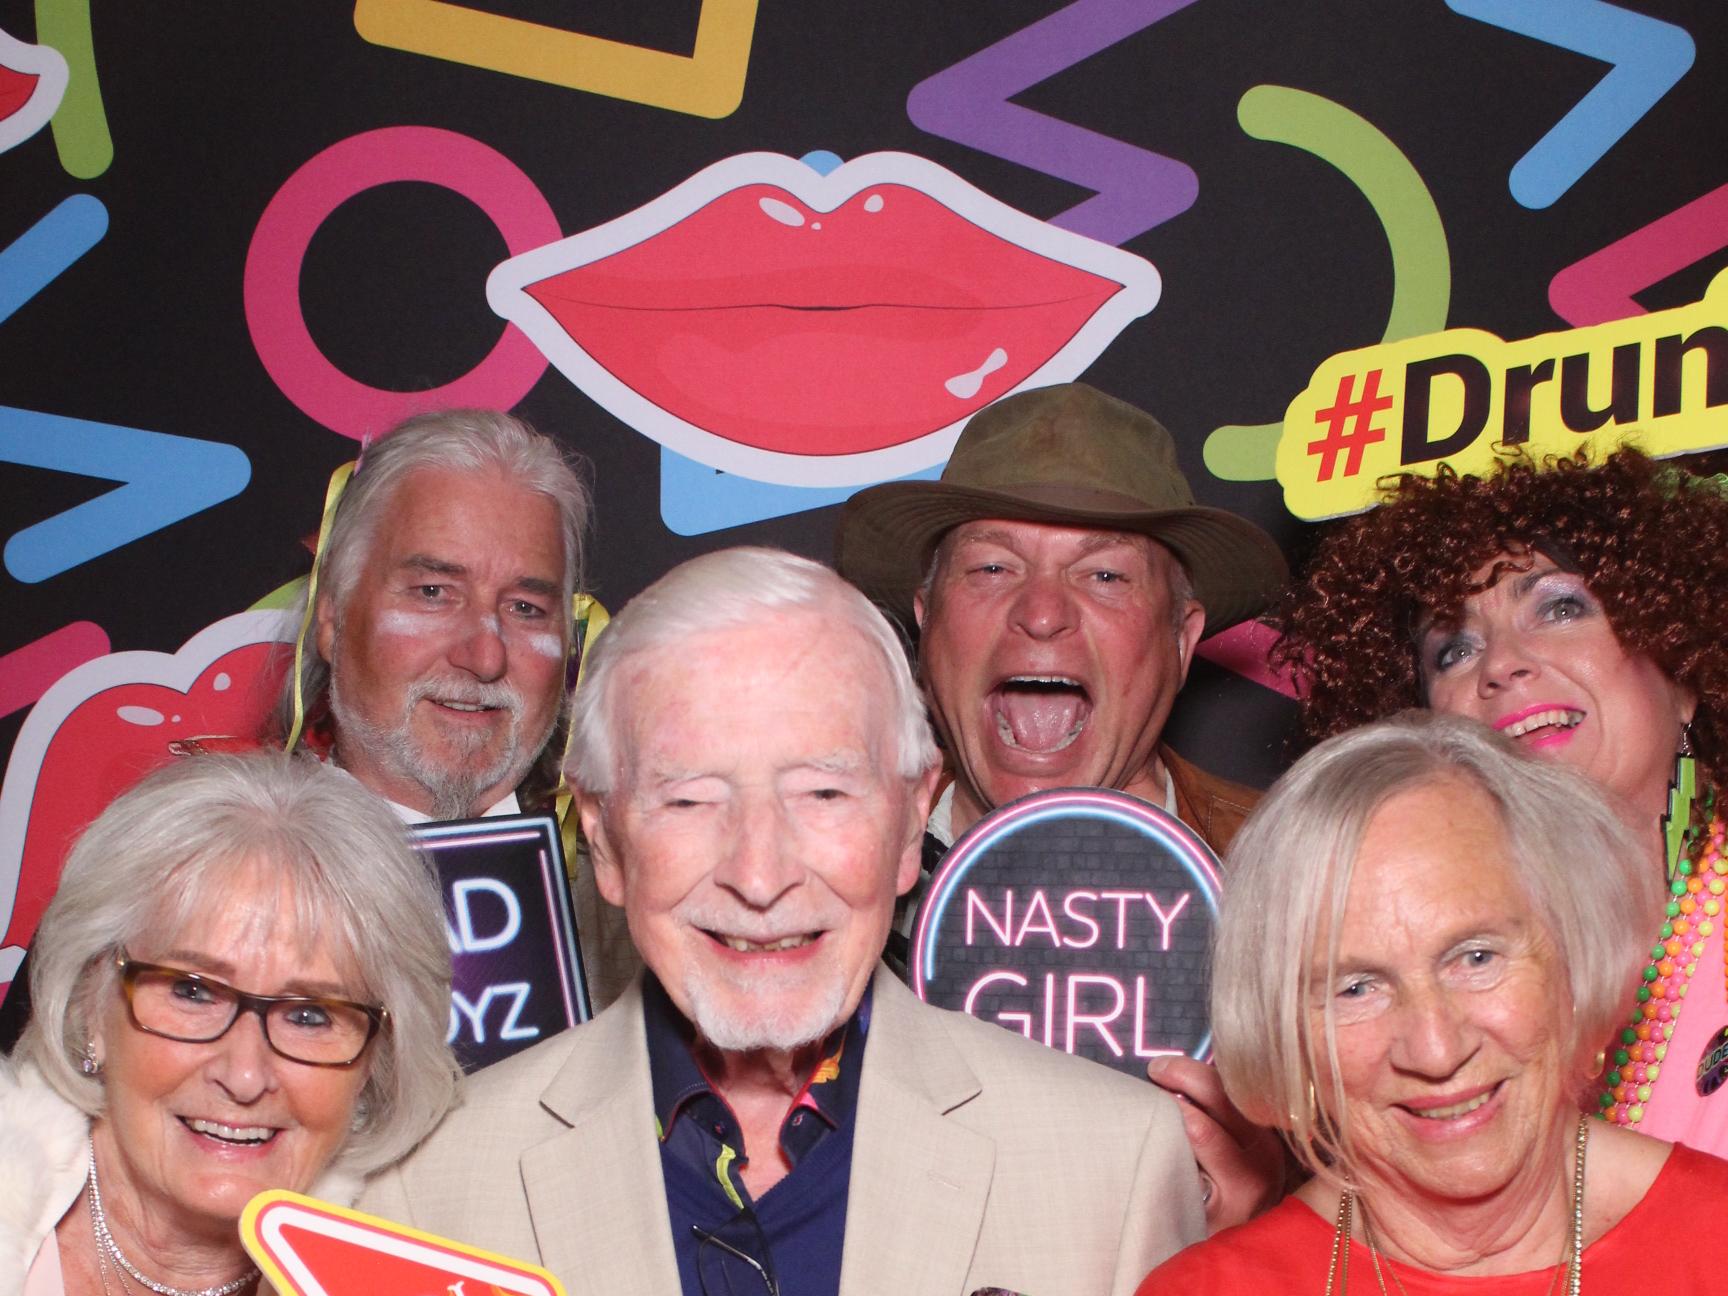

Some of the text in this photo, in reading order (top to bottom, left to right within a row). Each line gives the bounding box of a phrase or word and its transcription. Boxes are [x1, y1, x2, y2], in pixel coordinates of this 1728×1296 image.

[964, 888, 1190, 950] NASTY
[448, 981, 540, 1043] YZ
[965, 971, 1185, 1057] GIRL
